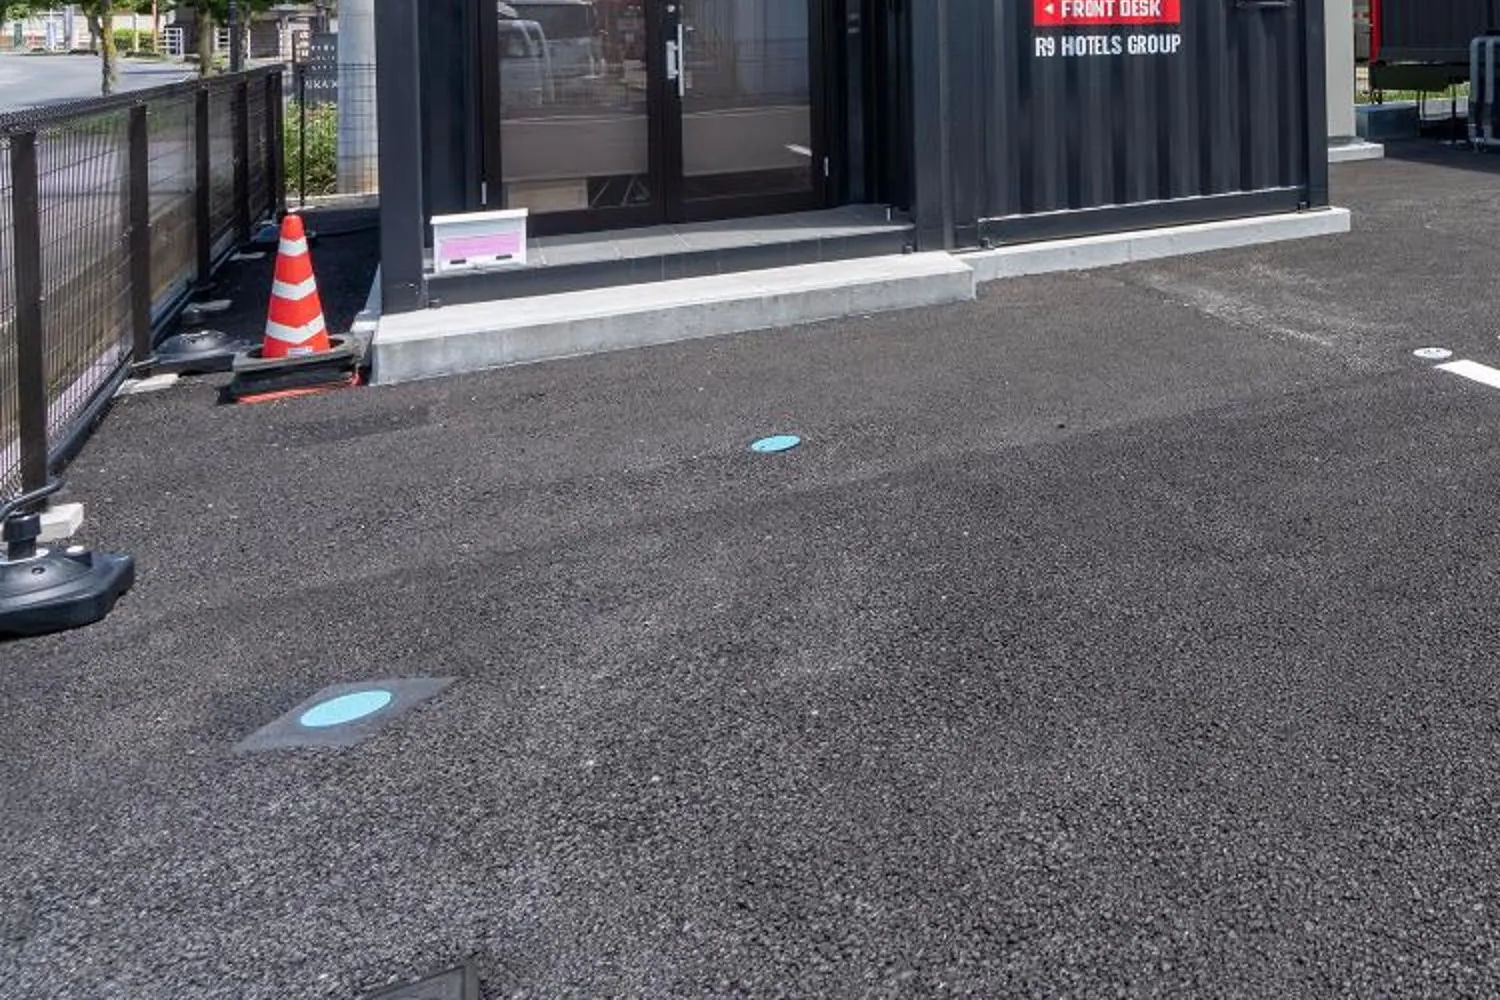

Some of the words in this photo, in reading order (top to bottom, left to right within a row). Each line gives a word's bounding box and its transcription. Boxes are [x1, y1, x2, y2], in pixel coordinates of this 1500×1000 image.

[1061, 0, 1116, 18] FRONT
[1035, 36, 1056, 57] R9
[1061, 35, 1123, 57] HOTELS
[1127, 33, 1182, 55] GROUP
